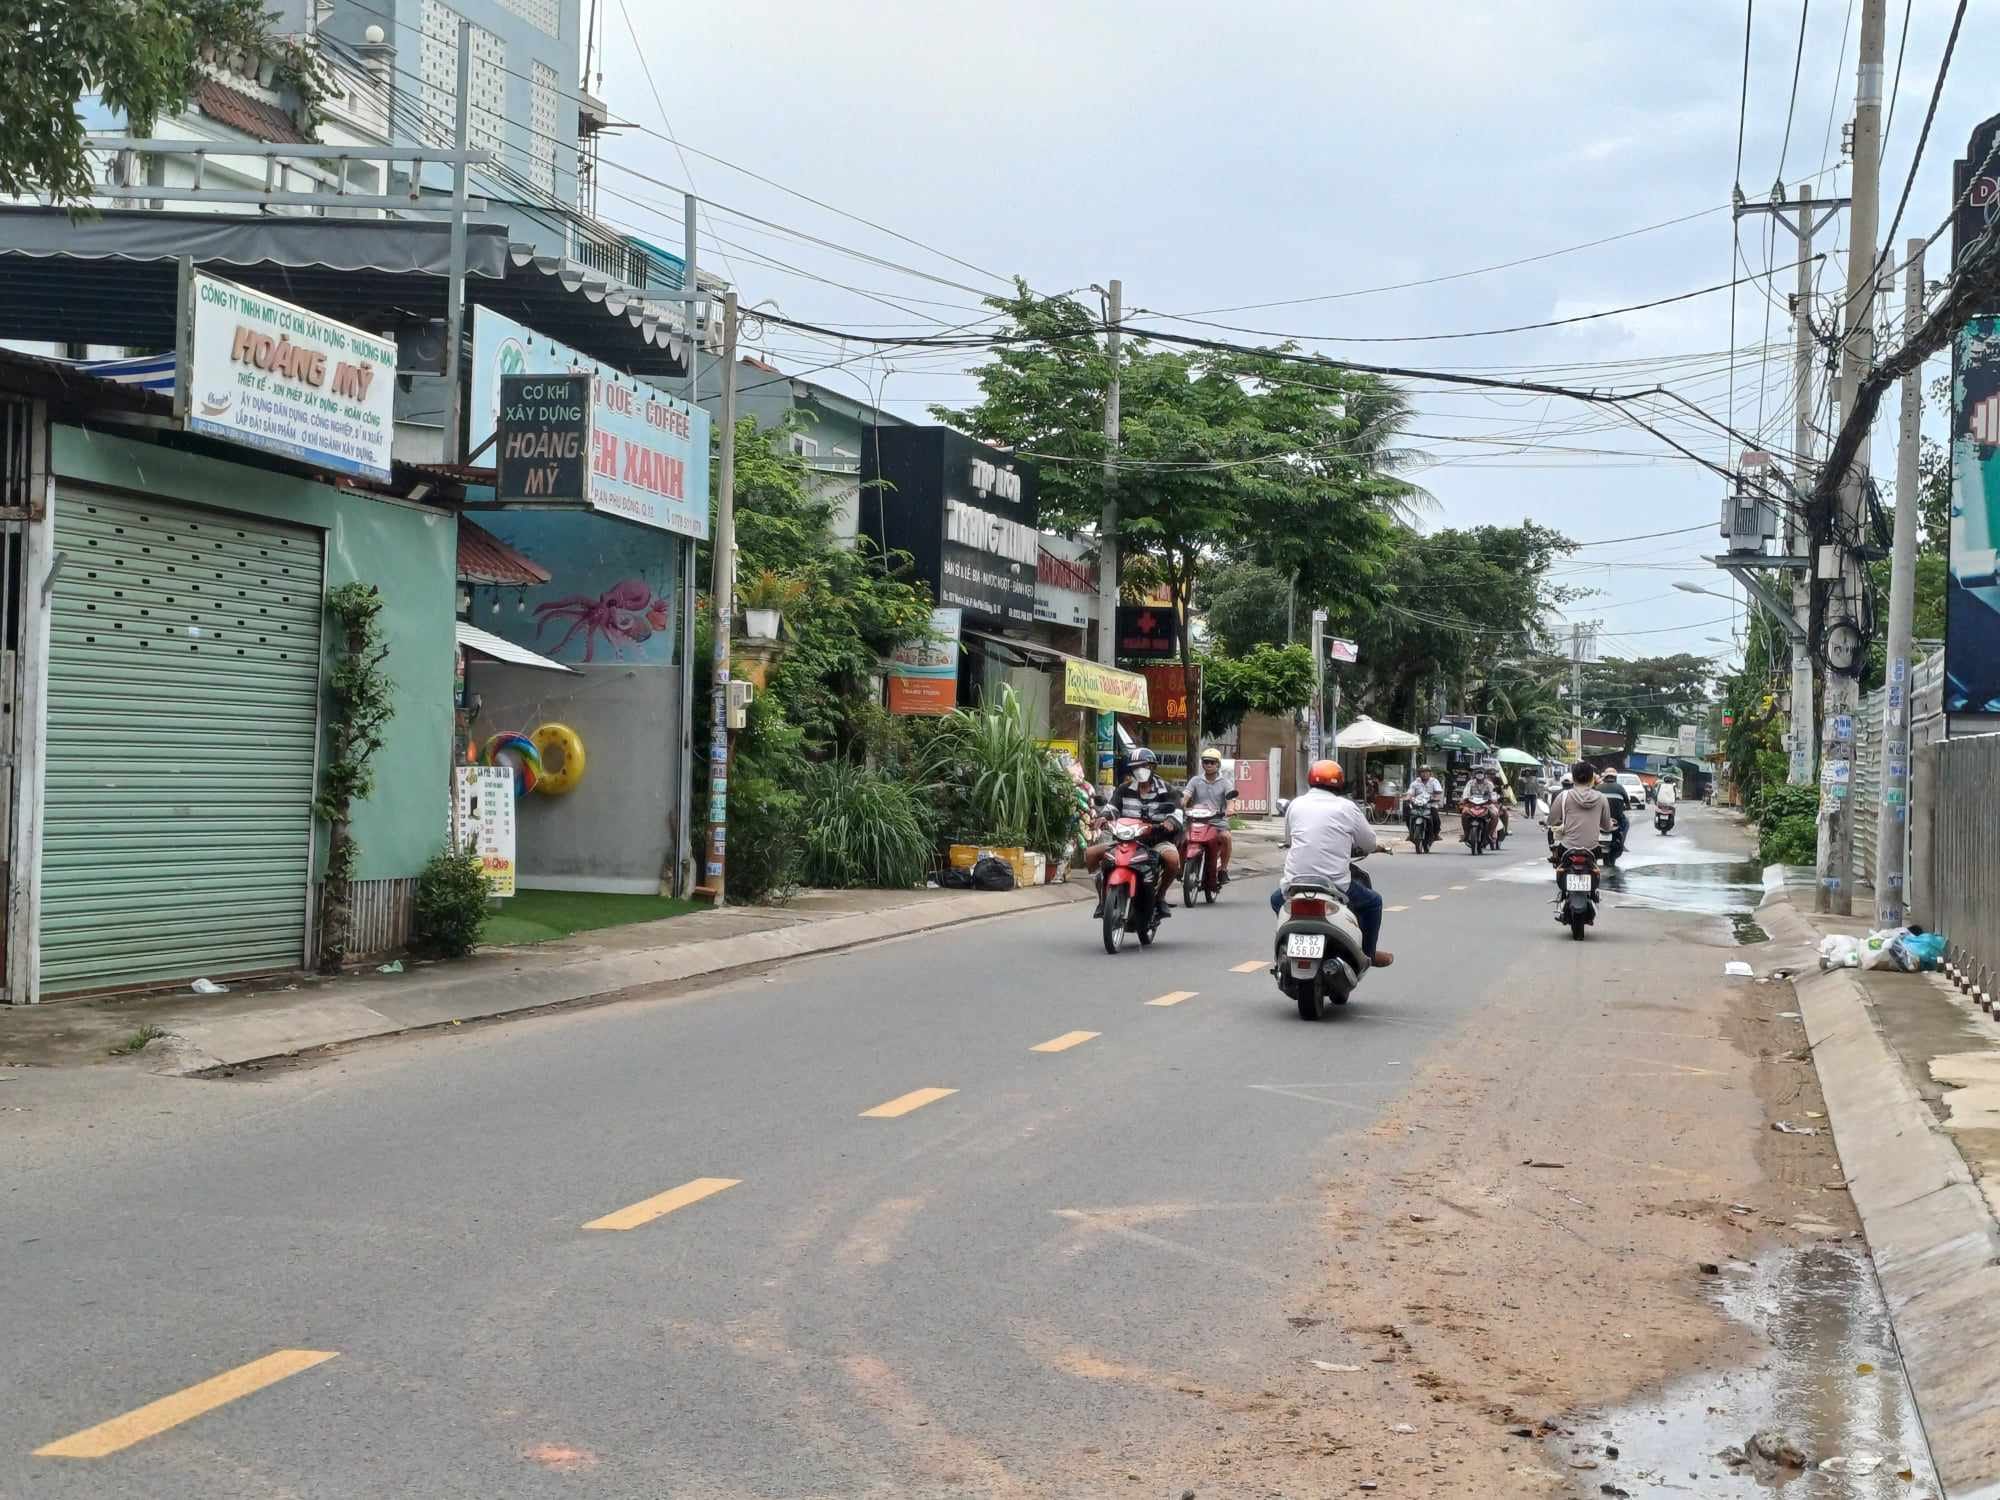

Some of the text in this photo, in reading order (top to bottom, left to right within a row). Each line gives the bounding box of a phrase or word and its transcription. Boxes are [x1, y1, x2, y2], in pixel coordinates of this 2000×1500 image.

[201, 283, 227, 307] CÔNG
[229, 294, 239, 311] TY
[240, 298, 261, 319] TNHH
[262, 307, 279, 326] MTV
[280, 311, 292, 329] CƠ
[306, 320, 322, 340] XÂY
[324, 328, 346, 350] DỰNG
[231, 326, 374, 402] HOÀNG MỸ
[237, 371, 256, 388] THIẾT
[257, 375, 268, 391] KẾ
[304, 391, 318, 408] XÂY
[363, 411, 381, 428] CÔNG
[522, 381, 571, 400] CƠ KHÍ
[311, 413, 329, 429] CÔNG
[505, 402, 582, 424] XÂY DỰNG
[646, 401, 690, 441] COFFEE
[504, 425, 580, 459] HOÀNG
[524, 462, 561, 495] MỸ
[623, 440, 686, 502] XANH
[945, 498, 999, 554] TRANG
